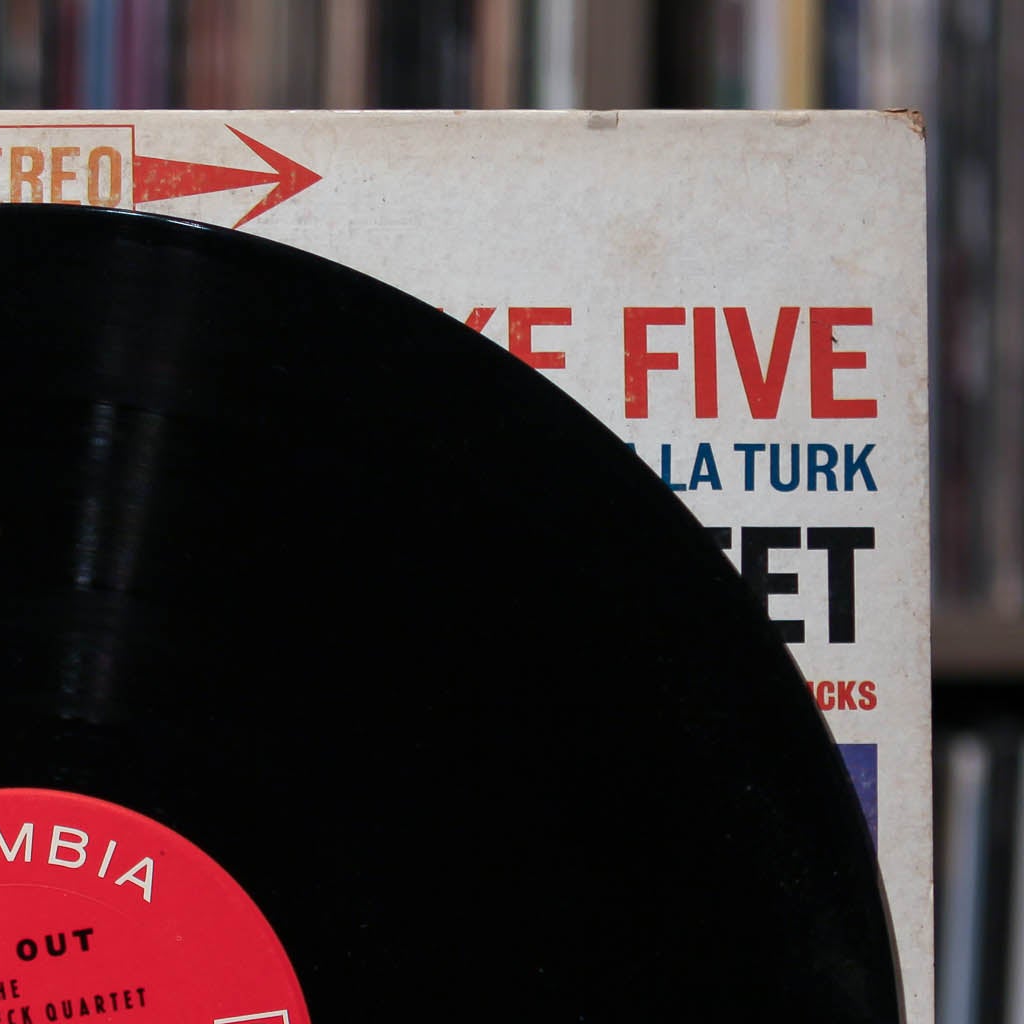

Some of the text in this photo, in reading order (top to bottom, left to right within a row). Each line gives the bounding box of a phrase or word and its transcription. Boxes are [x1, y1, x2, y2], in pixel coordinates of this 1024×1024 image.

[623, 306, 878, 420] FIVE
[661, 443, 878, 492] LA TURK
[703, 526, 875, 644] ET
[15, 927, 94, 962] OUT
[45, 987, 145, 1022] QUARTET
